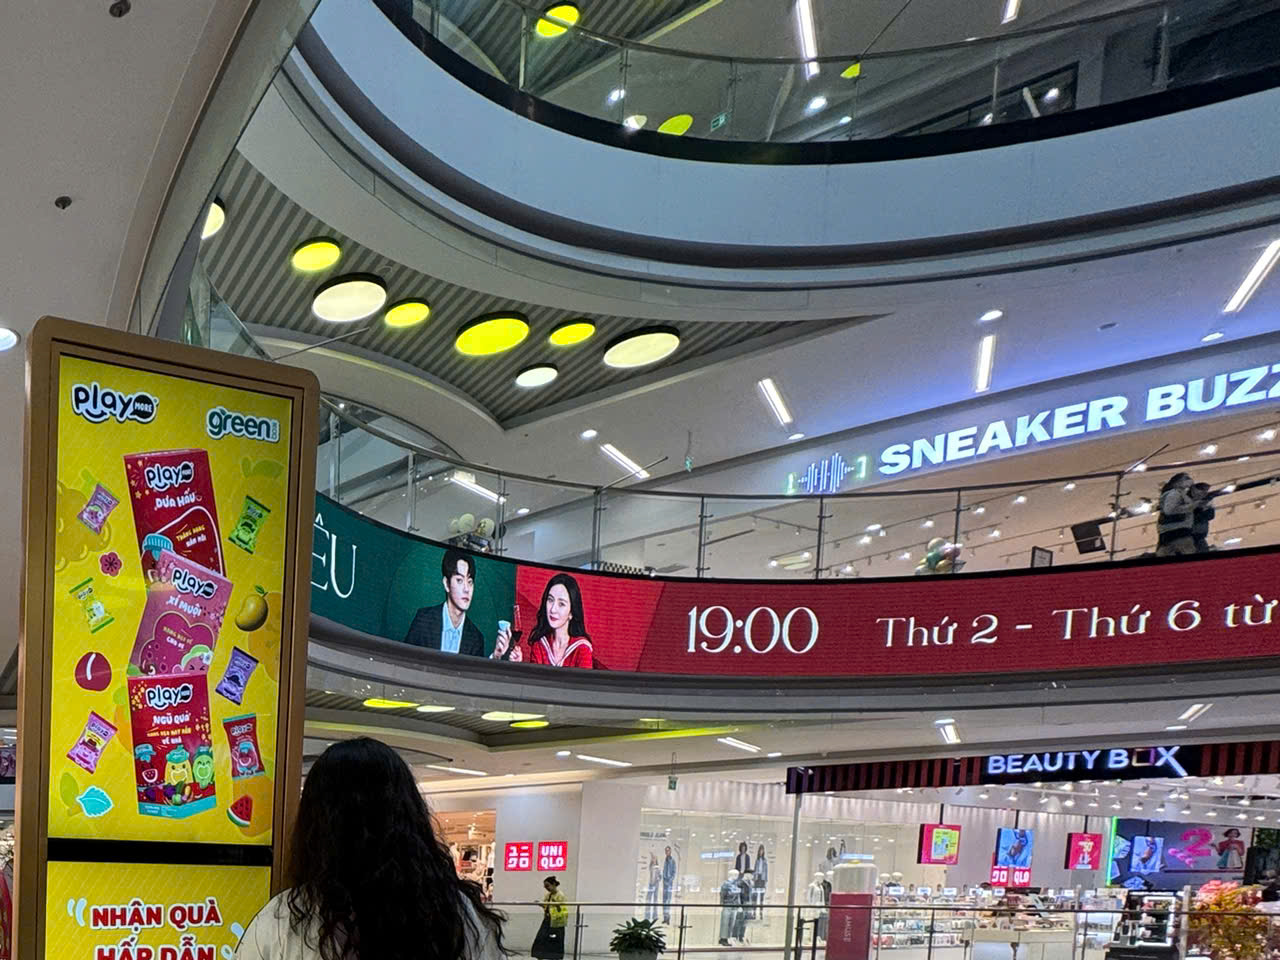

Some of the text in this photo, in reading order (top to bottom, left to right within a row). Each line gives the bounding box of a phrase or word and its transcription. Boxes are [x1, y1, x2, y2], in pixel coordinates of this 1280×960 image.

[134, 402, 153, 413] MORE
[208, 408, 271, 436] green
[879, 396, 1128, 476] SNEAKER
[687, 605, 819, 654] 19:00
[876, 616, 957, 648] Thứ
[971, 614, 998, 645] 2
[1051, 607, 1151, 641] Thứ
[1167, 600, 1201, 631] 6
[1224, 593, 1279, 628] từ
[987, 750, 1101, 774] BEAUTY
[542, 845, 563, 856] UNI
[541, 857, 564, 869] QLO
[1014, 871, 1030, 884] QLO
[92, 900, 221, 931] NHẬN QUÀ
